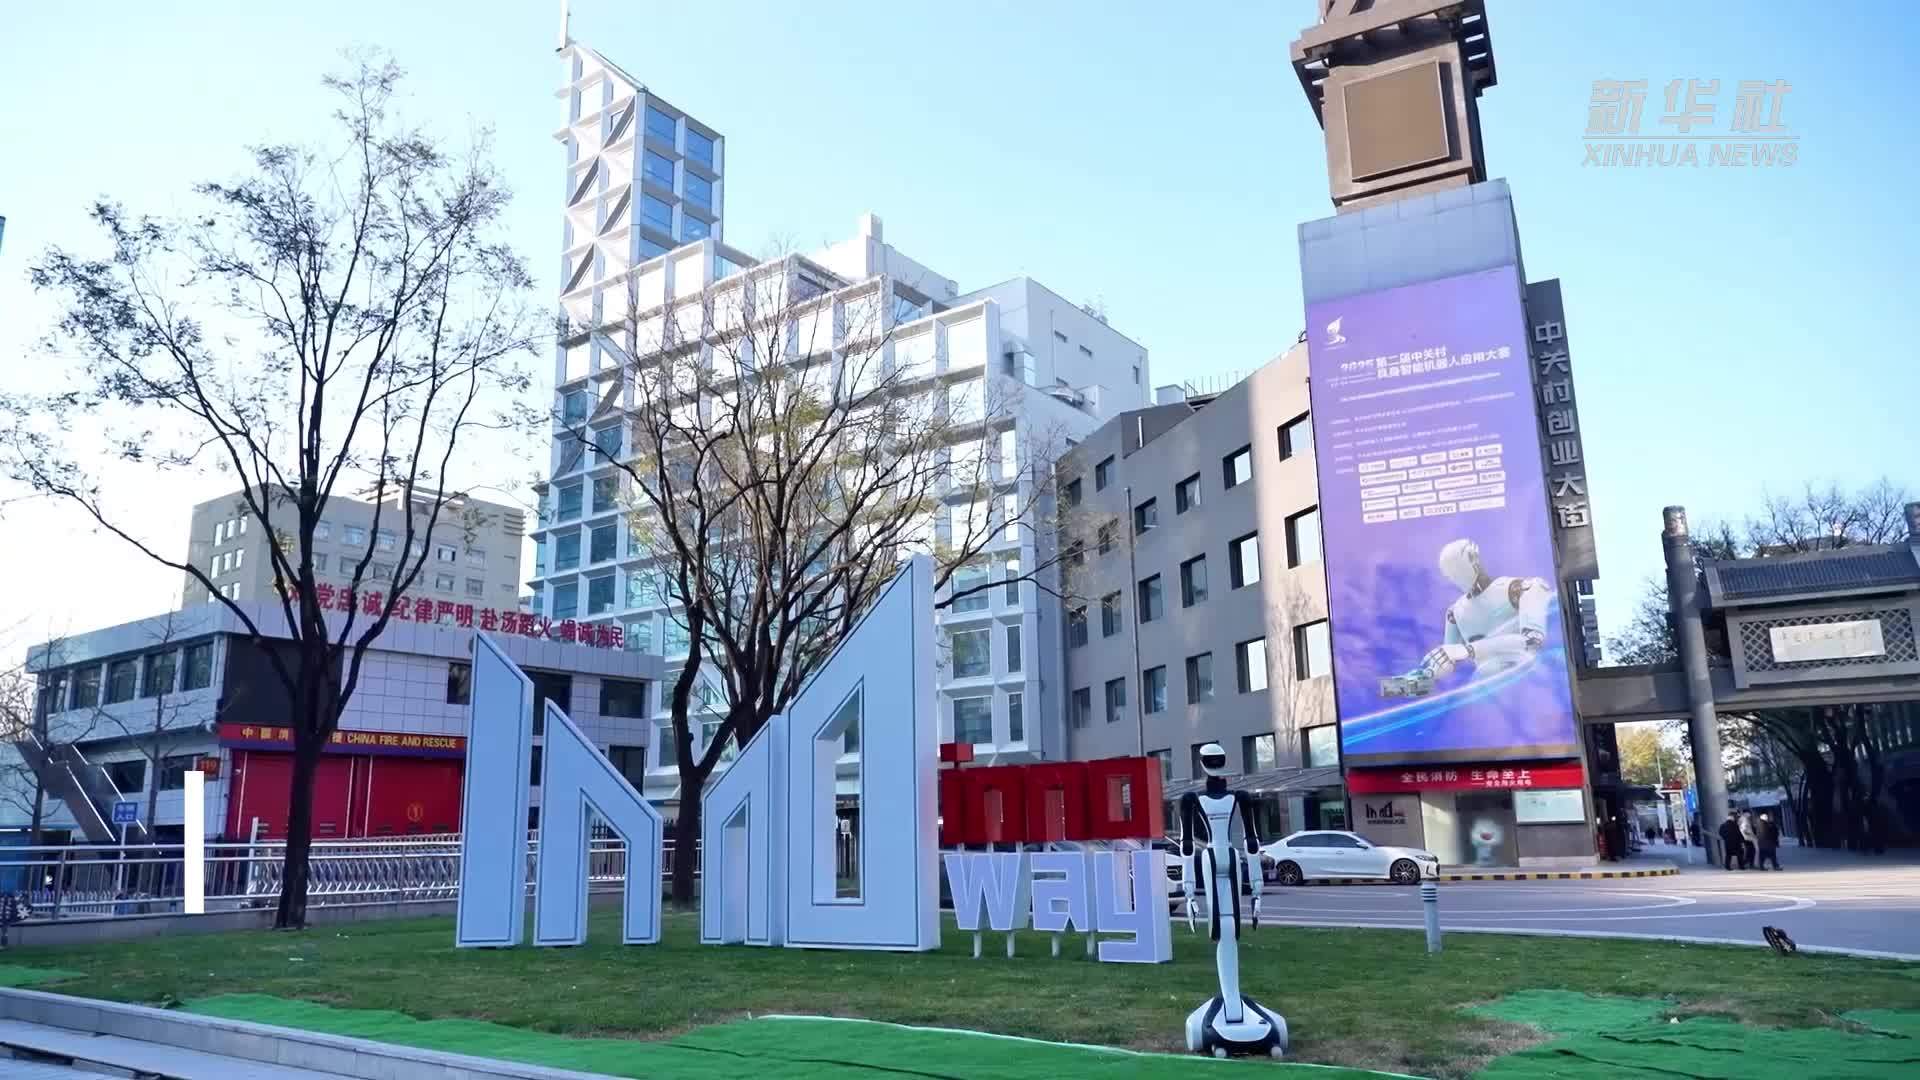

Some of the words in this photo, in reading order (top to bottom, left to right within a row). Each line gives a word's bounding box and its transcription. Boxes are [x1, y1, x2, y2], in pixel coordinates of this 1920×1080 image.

[346, 733, 377, 746] CHINA
[379, 735, 399, 747] FIRE
[400, 736, 421, 748] AND
[422, 737, 457, 749] RESCUE
